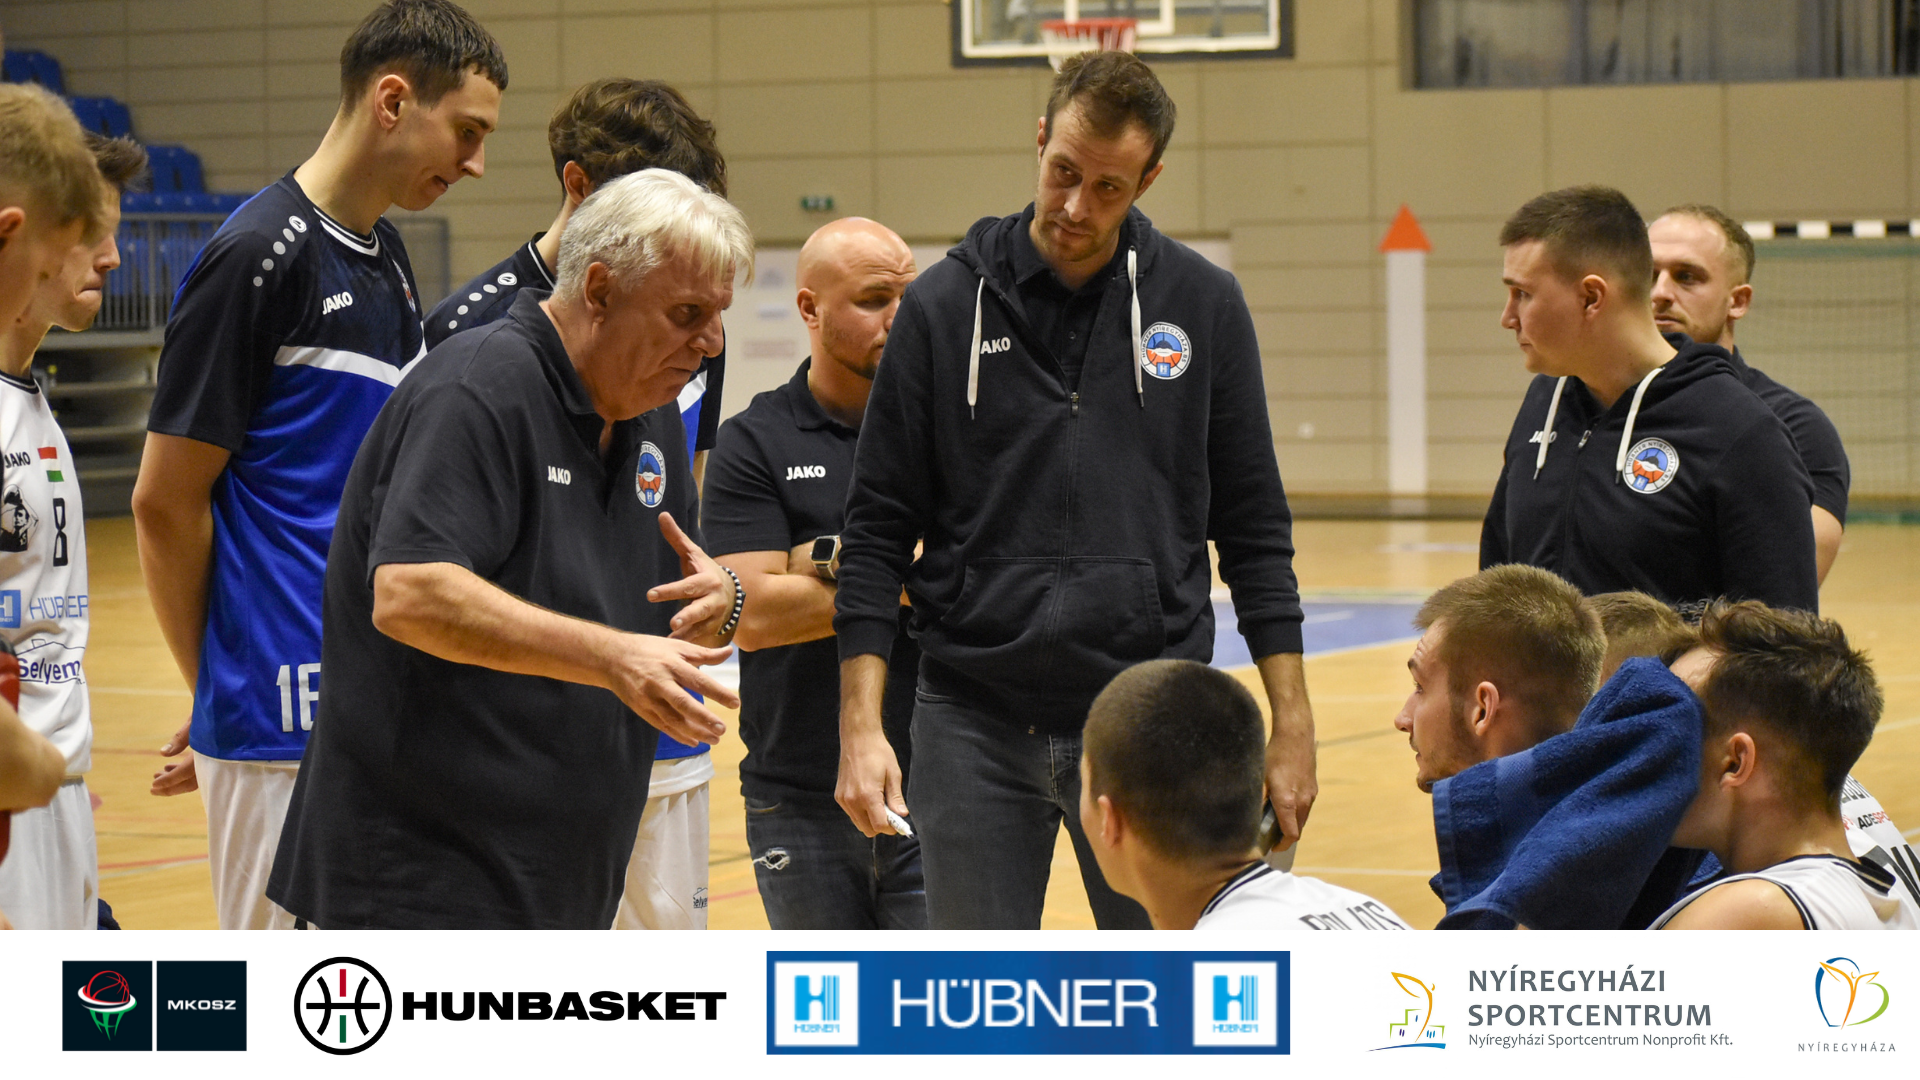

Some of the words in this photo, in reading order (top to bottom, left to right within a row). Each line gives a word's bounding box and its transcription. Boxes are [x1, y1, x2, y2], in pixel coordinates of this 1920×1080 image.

[322, 291, 354, 315] JAKO
[981, 337, 1011, 354] AKO
[1529, 431, 1558, 443] JAO
[4, 451, 31, 469] JAKO
[547, 465, 572, 485] JAKO
[786, 465, 826, 480] JAKO
[53, 497, 69, 567] 8
